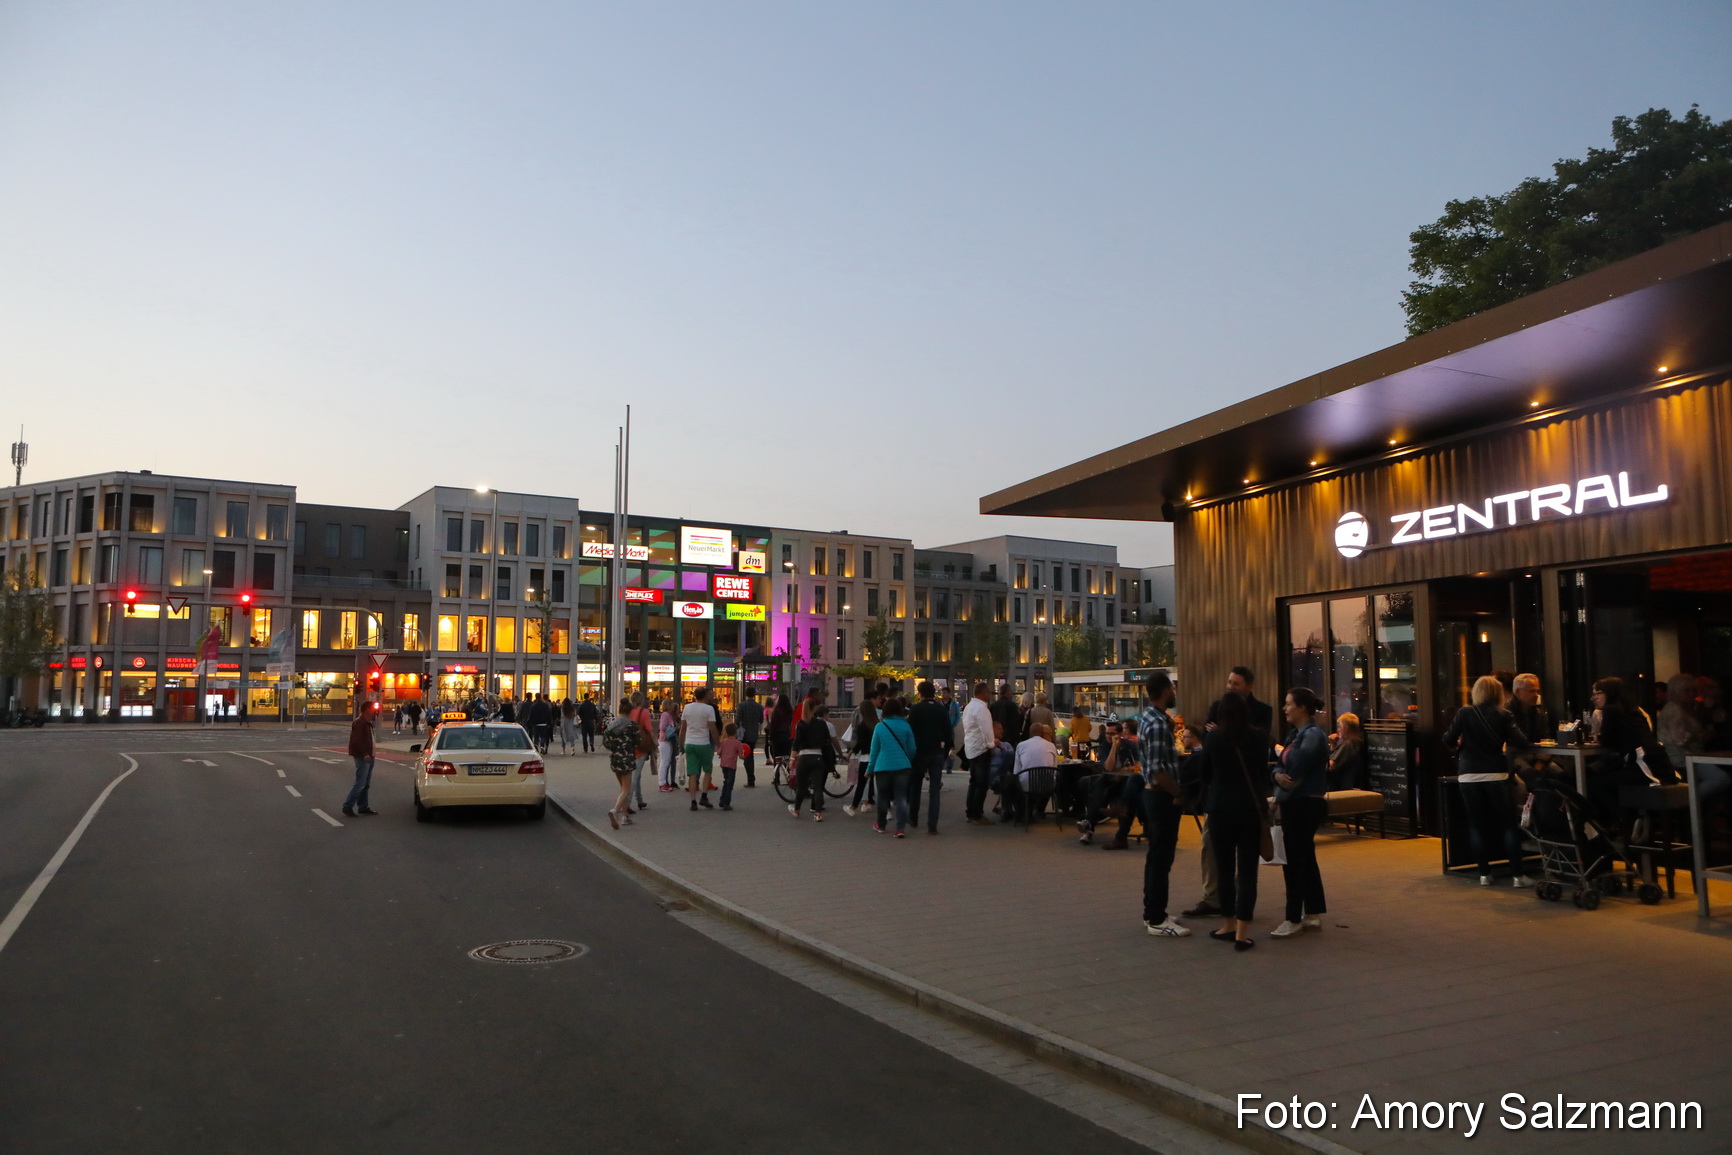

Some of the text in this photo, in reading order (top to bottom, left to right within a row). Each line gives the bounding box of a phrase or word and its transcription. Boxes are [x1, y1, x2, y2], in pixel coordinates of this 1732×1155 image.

[1390, 470, 1669, 546] ZENTRAL
[585, 545, 615, 556] Media
[745, 554, 761, 566] dm
[716, 577, 750, 590] REWE
[716, 588, 750, 599] CENTER
[729, 610, 754, 618] jumpers
